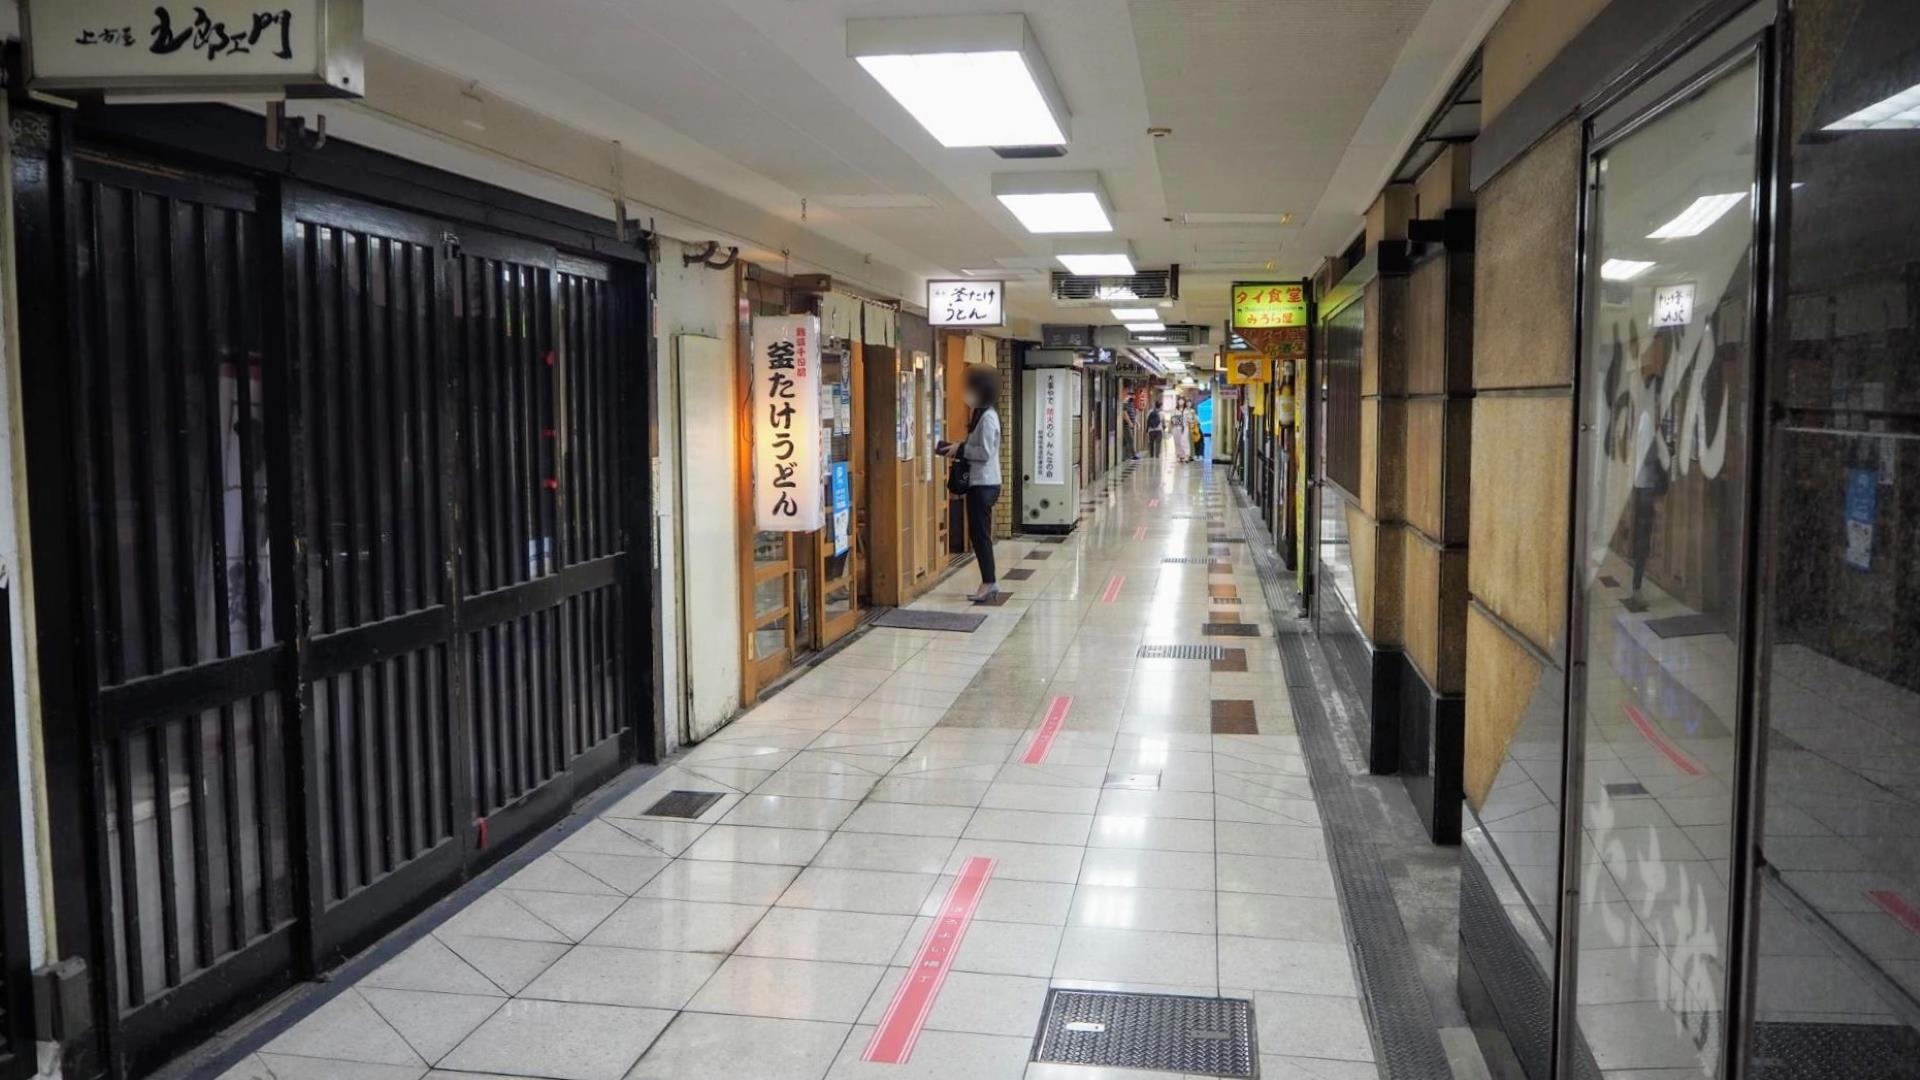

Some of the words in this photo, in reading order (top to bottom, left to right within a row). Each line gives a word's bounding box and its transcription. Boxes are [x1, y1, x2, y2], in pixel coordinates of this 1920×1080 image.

[1236, 286, 1303, 305] タイ食堂
[766, 340, 798, 517] 釜たけうどん
